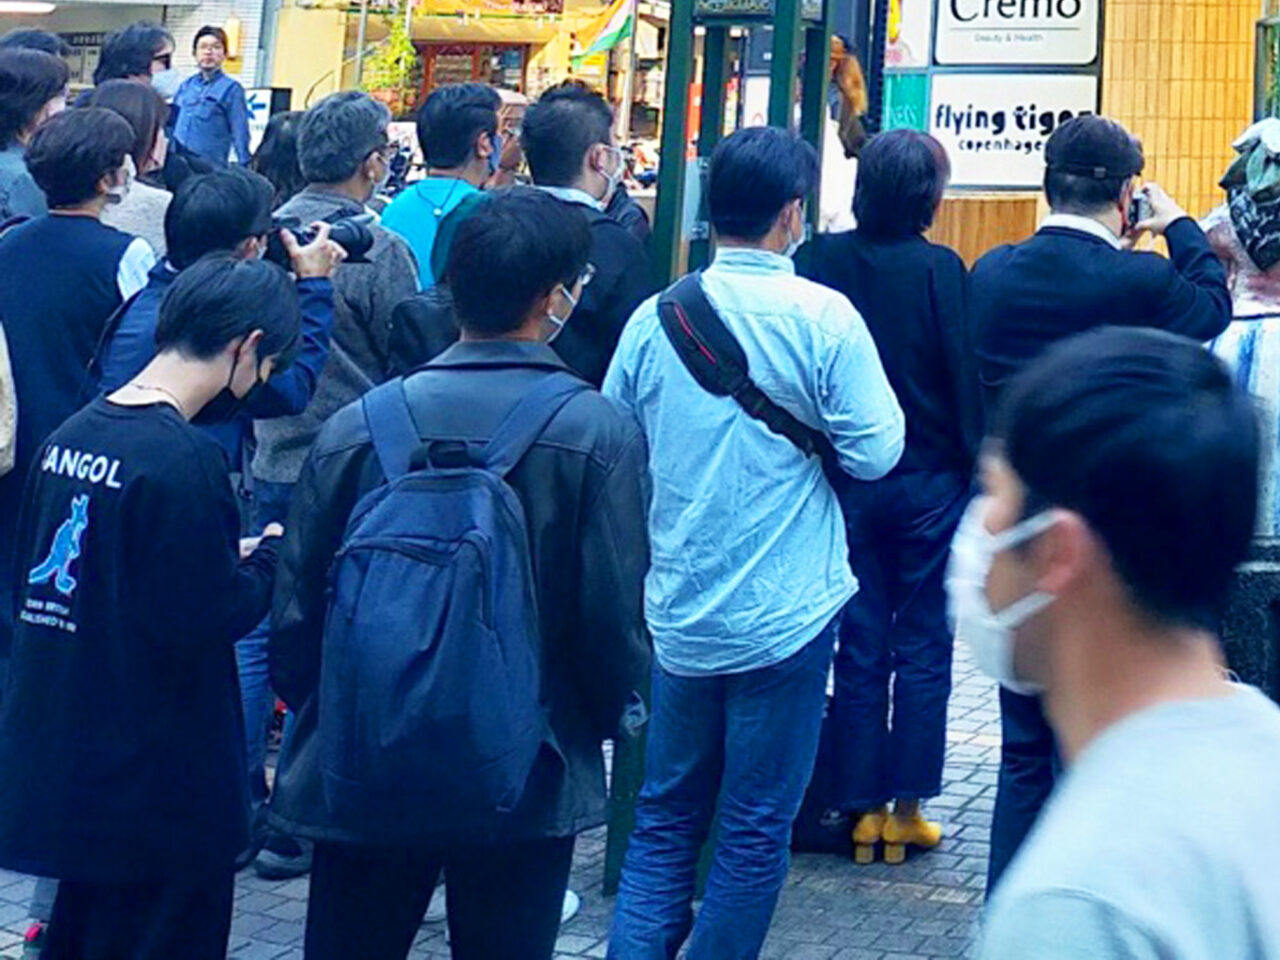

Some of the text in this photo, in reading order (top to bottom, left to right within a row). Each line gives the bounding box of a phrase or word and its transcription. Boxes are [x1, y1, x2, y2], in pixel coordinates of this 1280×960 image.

[935, 104, 1006, 135] flying
[958, 138, 1044, 155] copenhage
[42, 445, 122, 489] ANGOL
